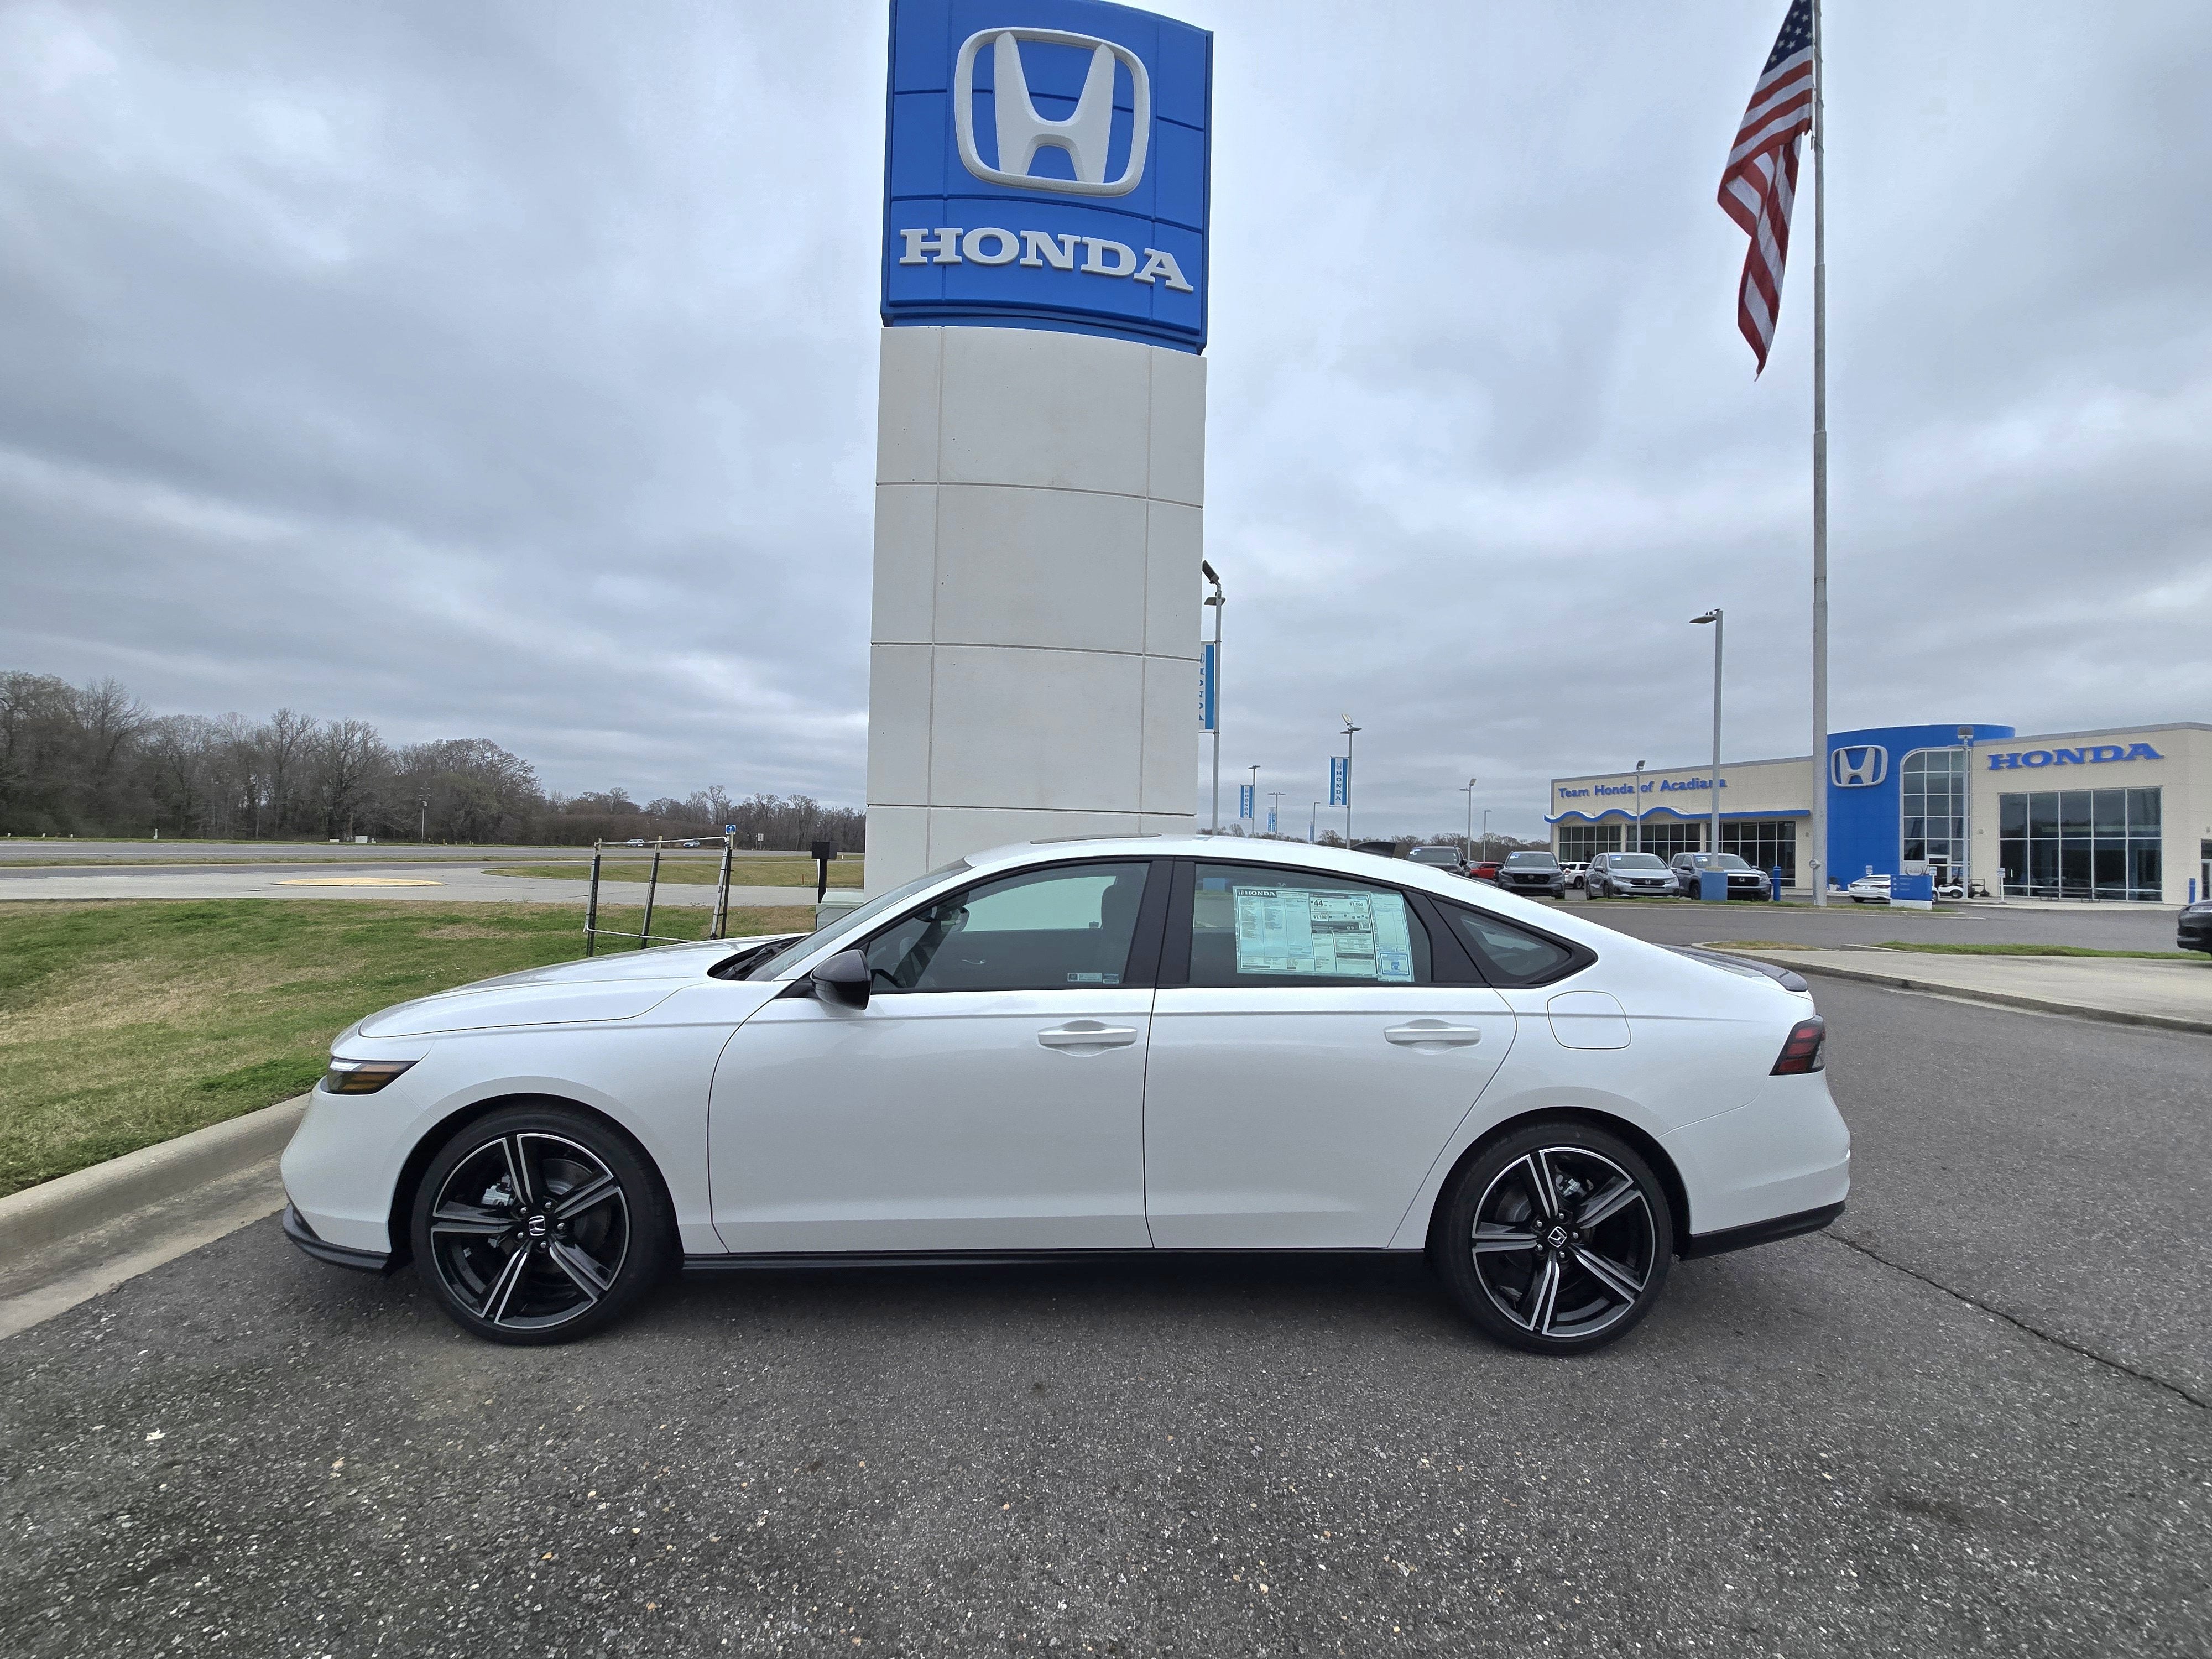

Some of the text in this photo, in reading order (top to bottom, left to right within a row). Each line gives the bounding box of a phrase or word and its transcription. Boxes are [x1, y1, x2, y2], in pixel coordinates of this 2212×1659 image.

[899, 227, 1194, 293] HONDA
[1987, 743, 2164, 770] HONDA
[1558, 787, 1590, 798] Team
[1594, 783, 1635, 796] Honda
[1640, 781, 1655, 792] of
